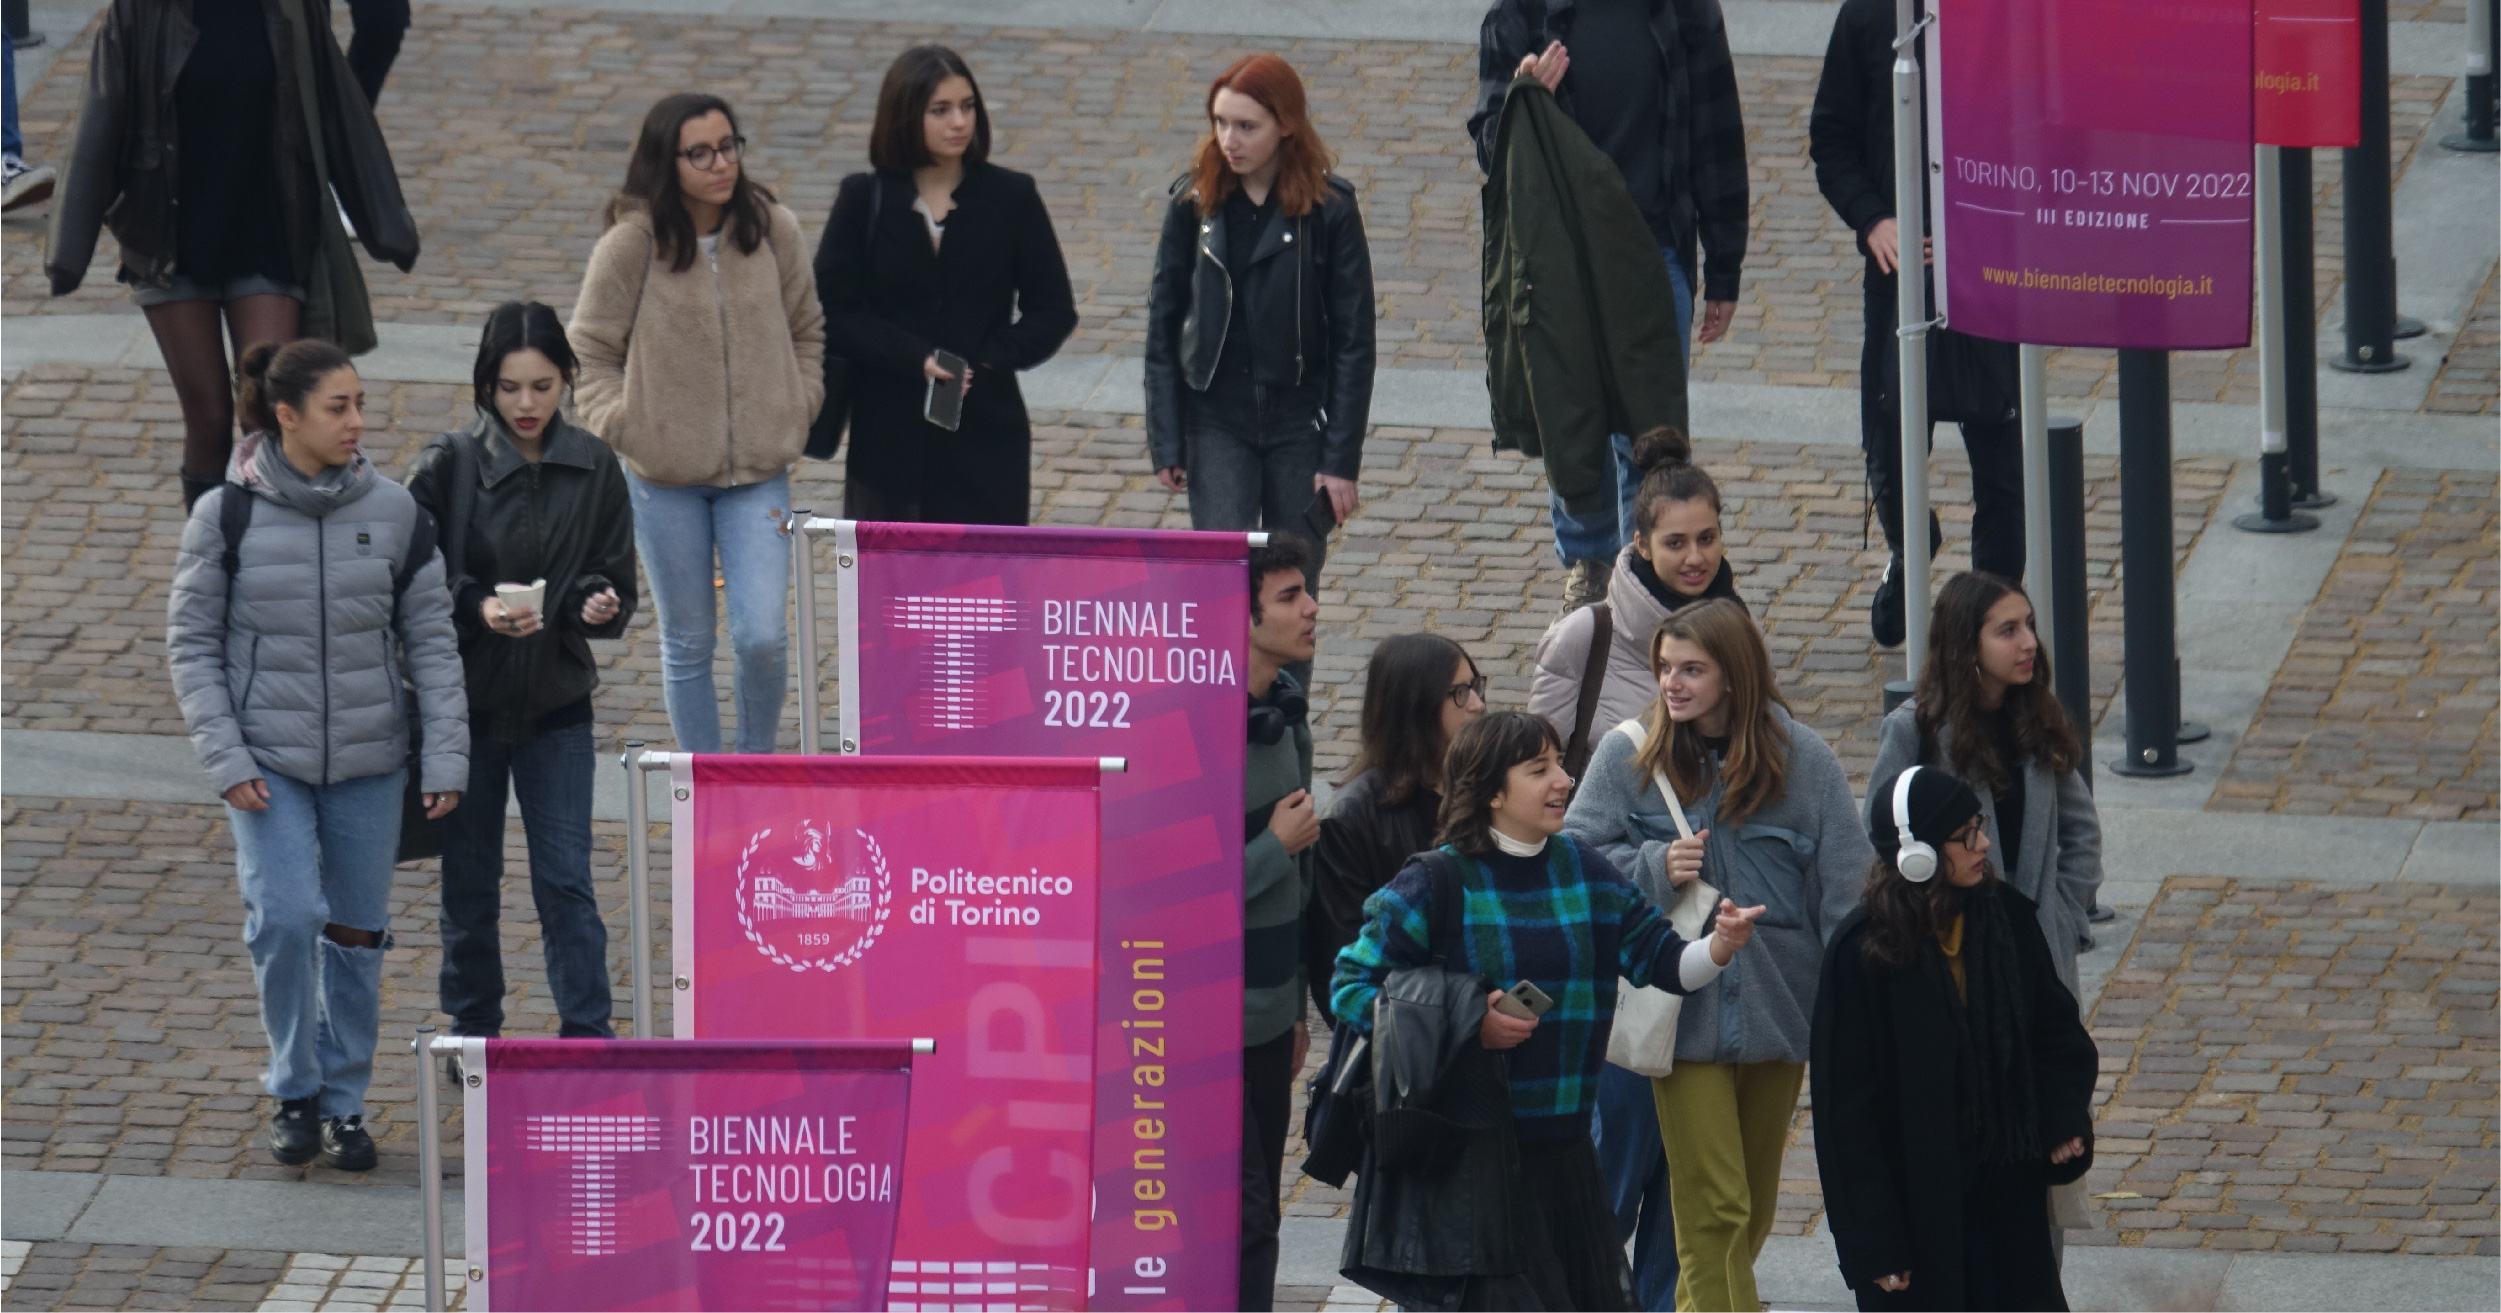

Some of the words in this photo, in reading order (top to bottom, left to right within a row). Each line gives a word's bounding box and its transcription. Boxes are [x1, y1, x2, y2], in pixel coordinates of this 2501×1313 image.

[1954, 156, 2043, 193] TORINO,
[2050, 167, 2115, 195] 10-13
[2121, 172, 2179, 198] NOV
[2185, 172, 2252, 198] 2022
[2036, 207, 2057, 225] III
[2064, 209, 2150, 229] EDIZIONE
[1982, 263, 2214, 299] www.biennaletecnologia.it
[1042, 599, 1199, 638] BIENNALE
[1042, 645, 1237, 685] TECNOLOGIA
[1043, 690, 1132, 728] 2022
[910, 868, 1073, 896] Politecnico
[909, 900, 936, 925] di
[944, 900, 1041, 926] Torino
[796, 932, 831, 947] 1859
[1121, 939, 1178, 1231] generazioni
[690, 1115, 857, 1155] BIENNALE
[688, 1163, 892, 1203] TECNOLOGIA
[689, 1211, 787, 1252] 2022
[1124, 1255, 1167, 1295] le
